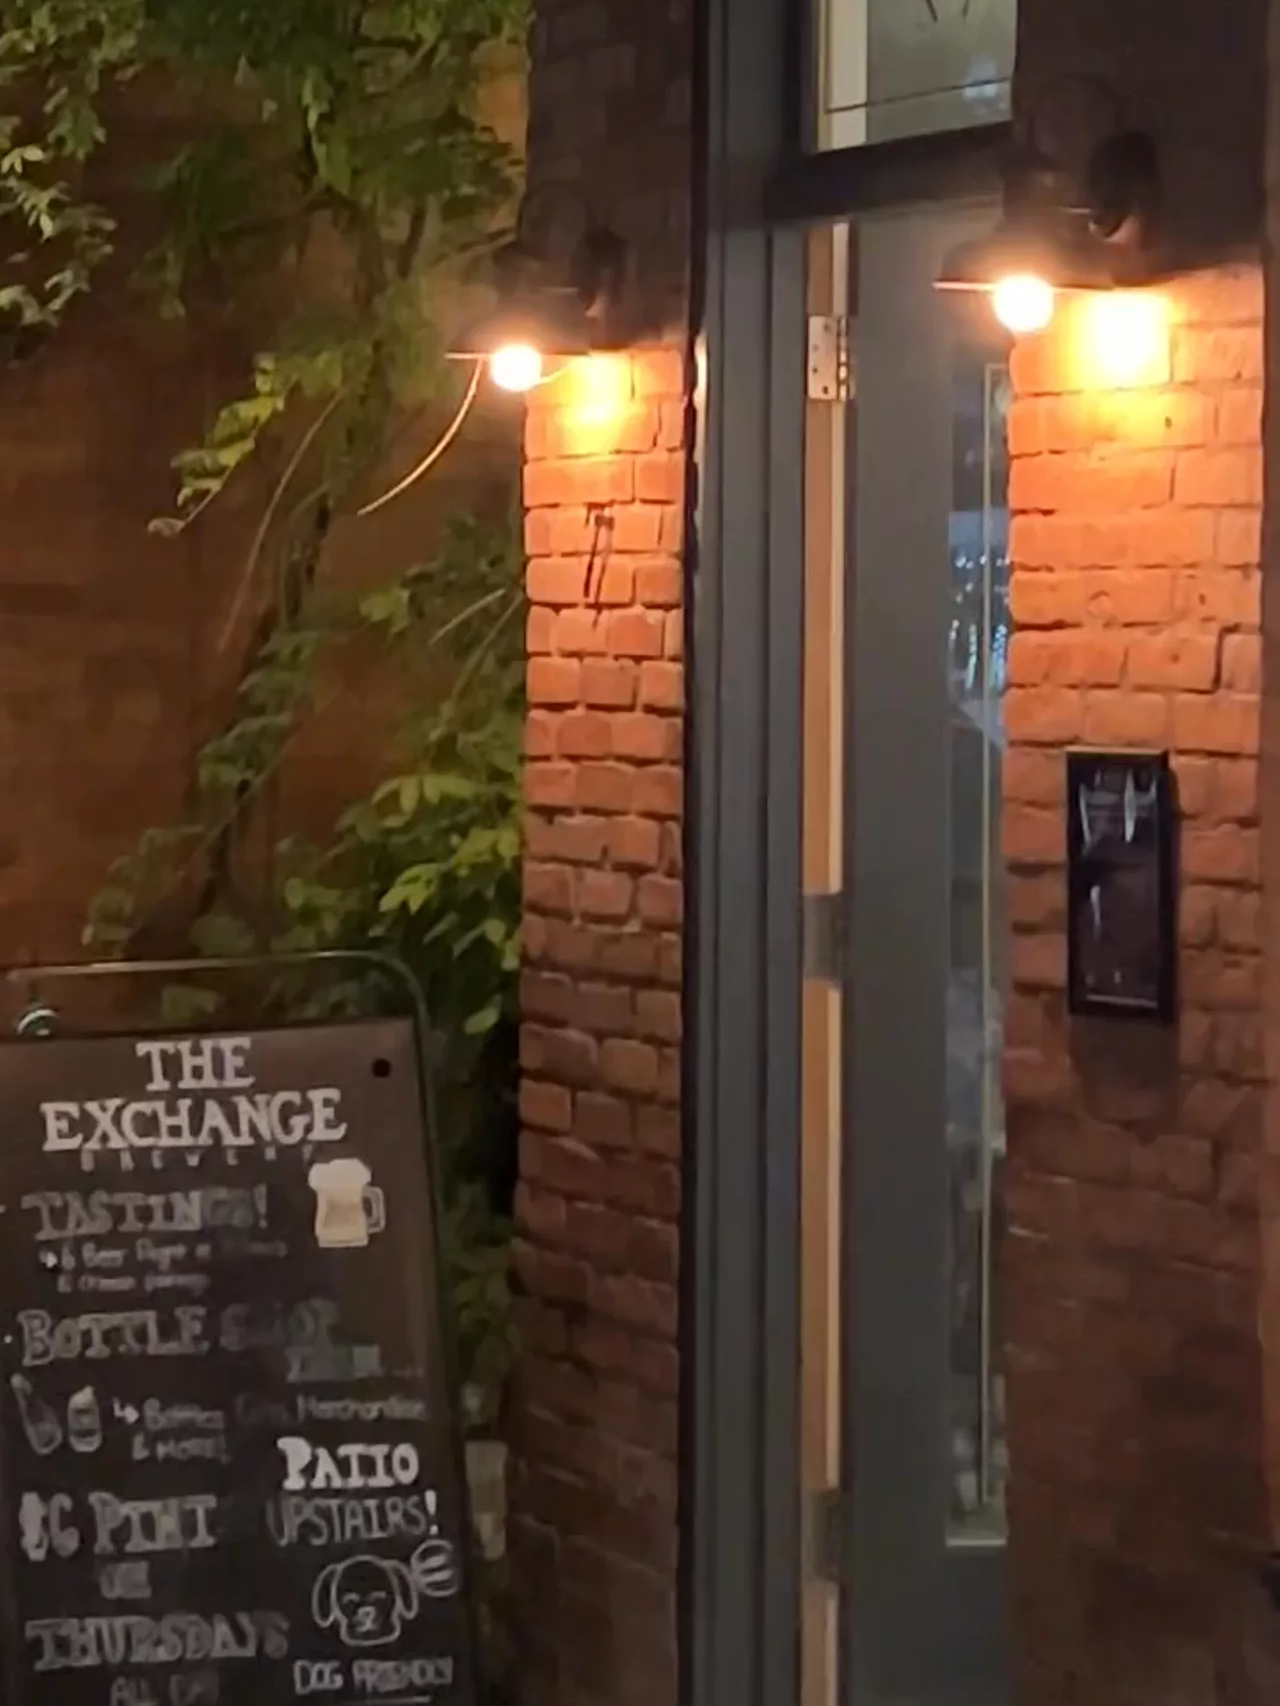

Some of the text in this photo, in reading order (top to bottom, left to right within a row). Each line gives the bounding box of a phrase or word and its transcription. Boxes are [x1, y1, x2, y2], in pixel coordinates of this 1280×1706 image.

[135, 1037, 256, 1092] THE
[40, 1088, 347, 1152] EXCHANGE
[17, 1305, 210, 1367] BOTTLE
[277, 1436, 419, 1491] PATIO
[266, 1489, 439, 1548] UPSTAIRS!
[24, 1610, 291, 1673] THURSDAYS
[292, 1657, 345, 1696] DOG
